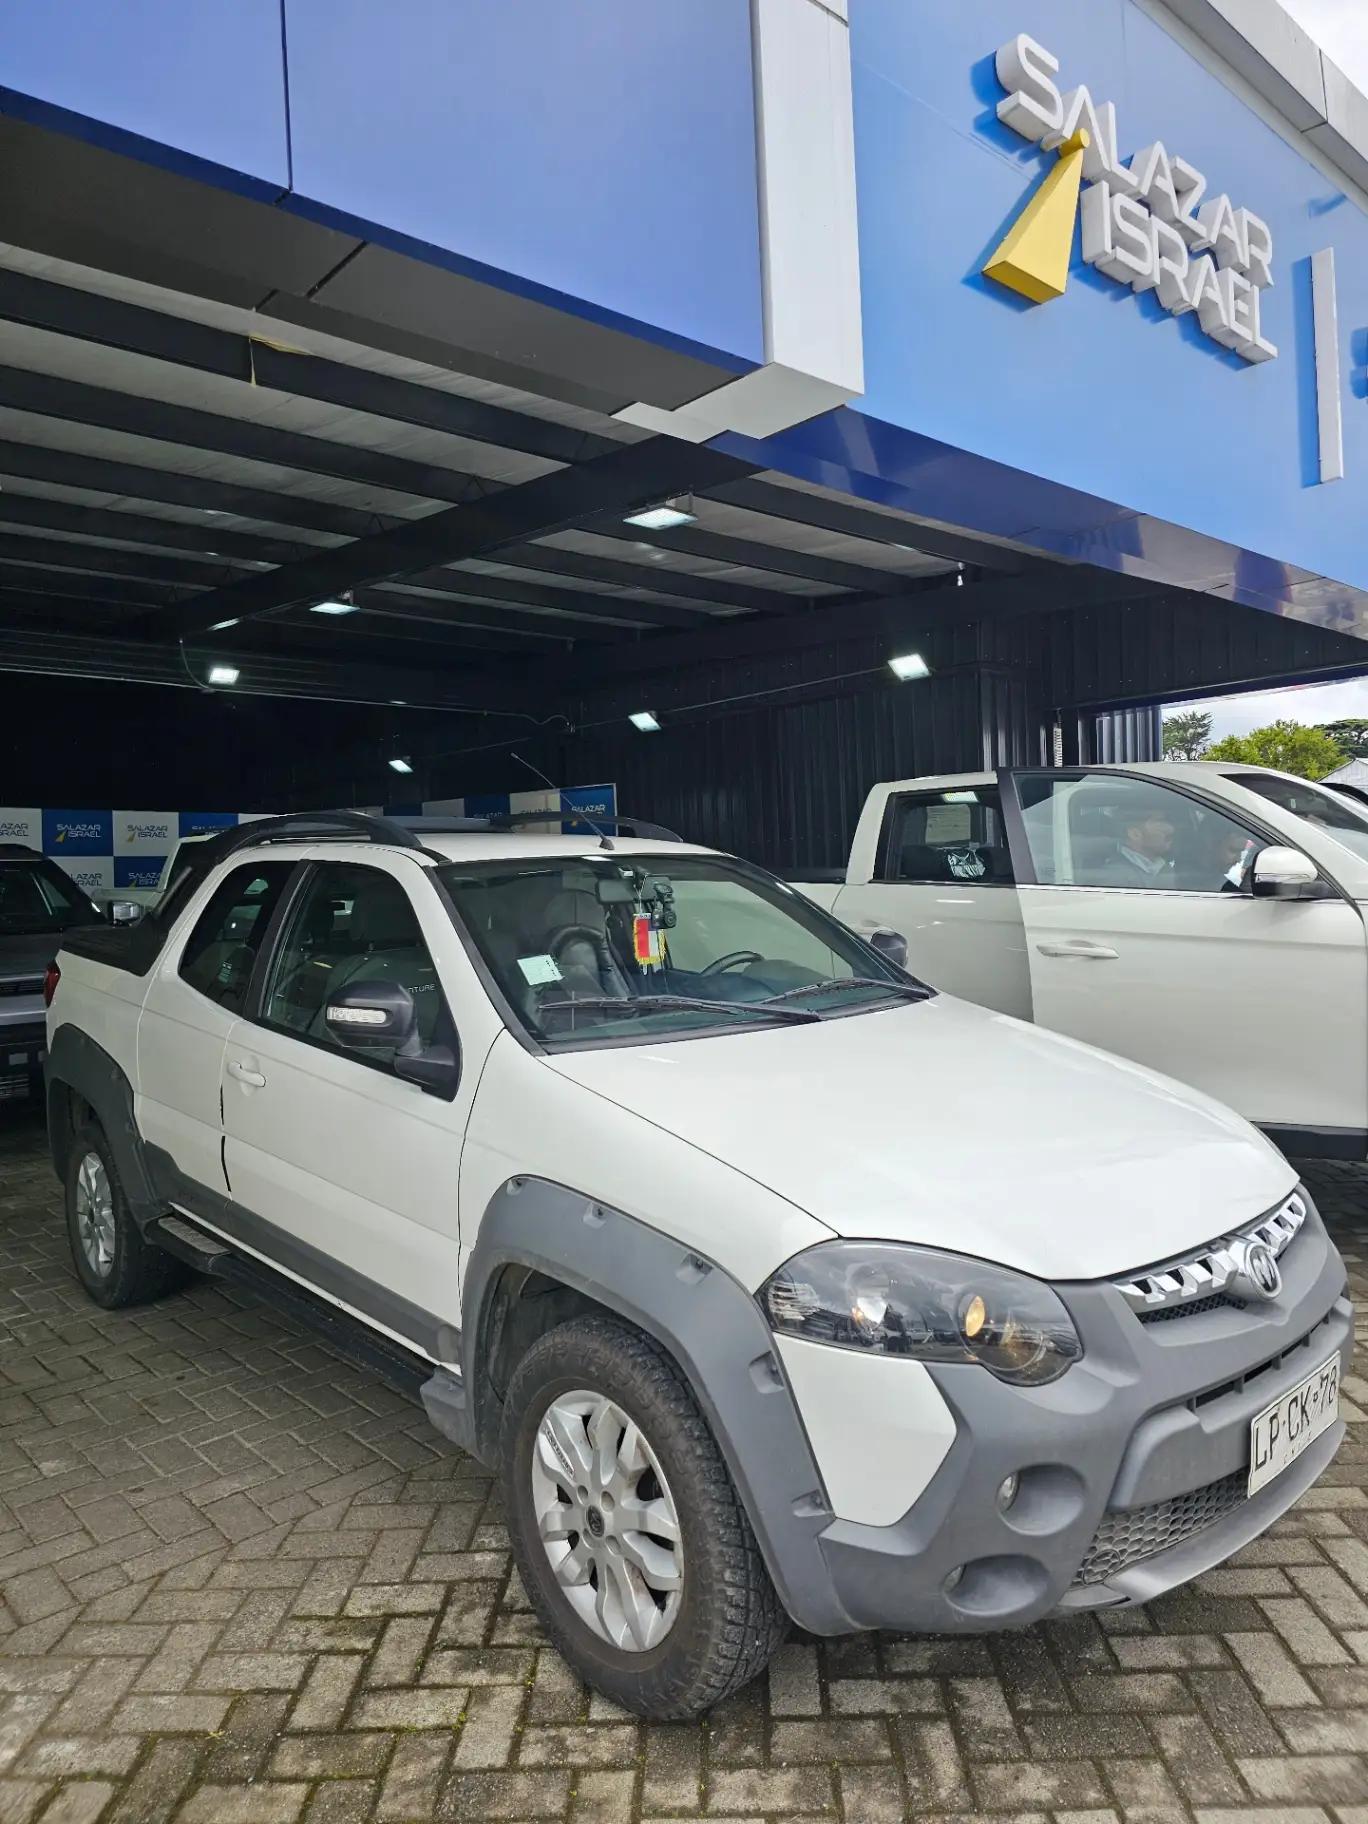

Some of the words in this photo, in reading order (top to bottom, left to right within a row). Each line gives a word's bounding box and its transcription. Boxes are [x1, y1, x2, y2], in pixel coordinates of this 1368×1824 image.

[996, 33, 1274, 287] SALAZAR
[1080, 180, 1278, 365] ISRAEL
[56, 823, 101, 832] SALAZAR
[68, 830, 102, 838] ISRAEL
[138, 831, 168, 839] ISRAEL
